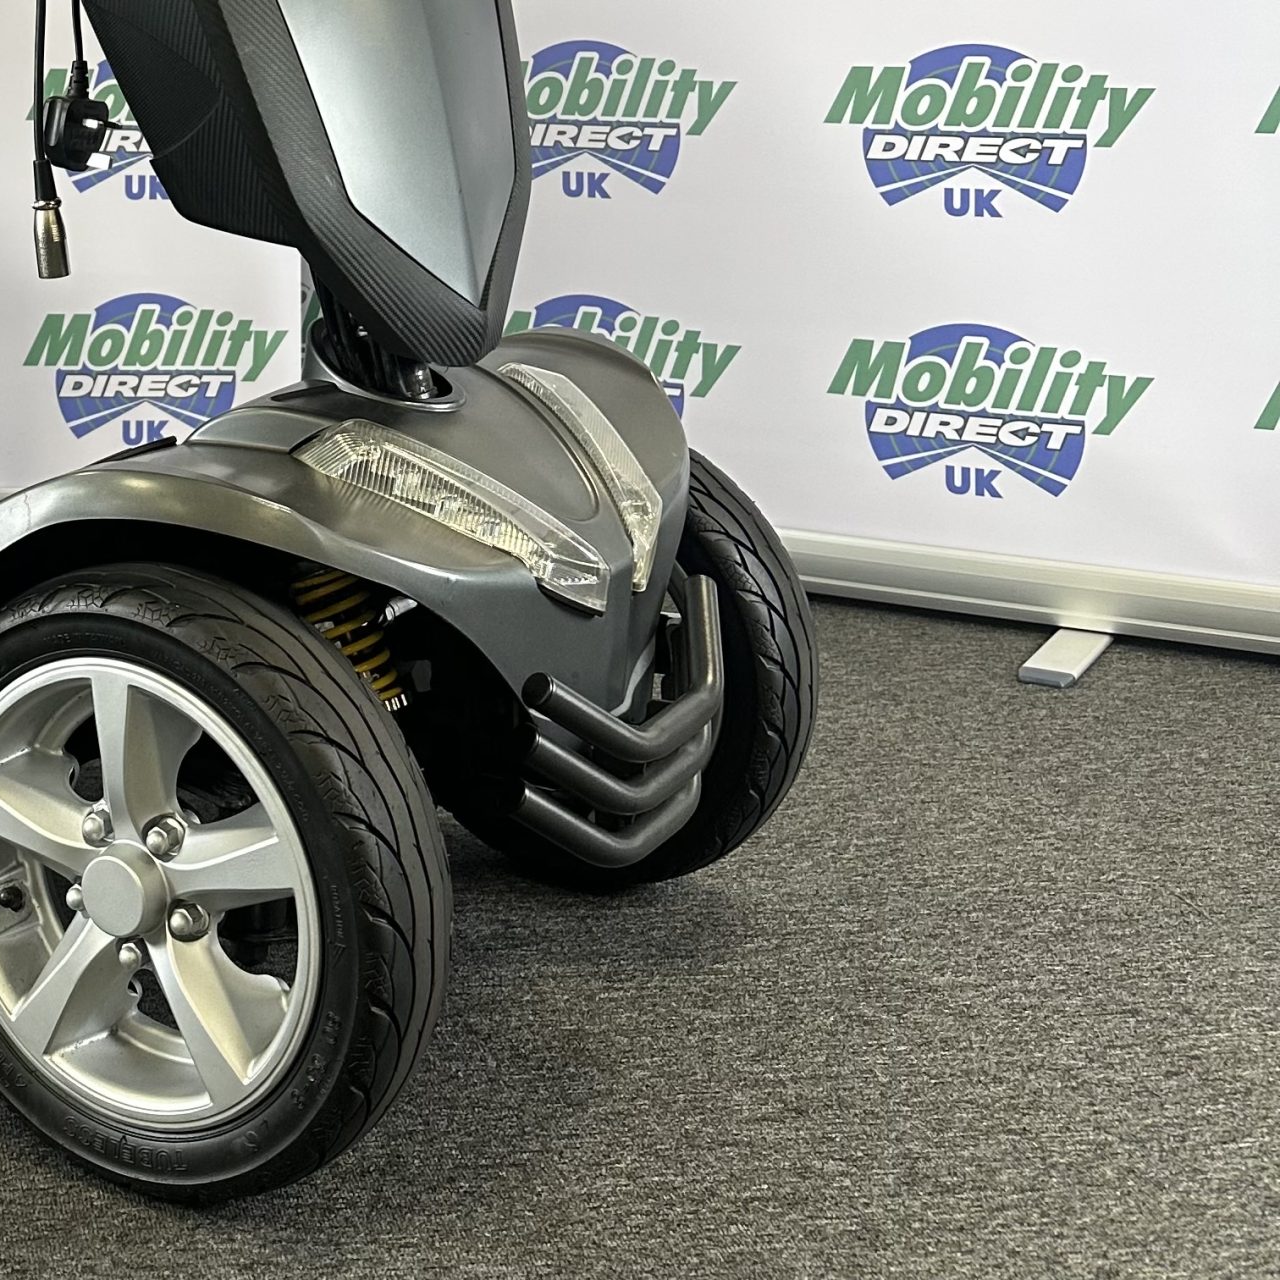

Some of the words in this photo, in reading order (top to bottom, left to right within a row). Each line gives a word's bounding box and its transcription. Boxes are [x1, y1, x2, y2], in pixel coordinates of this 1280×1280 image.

[521, 57, 737, 136] obility
[823, 61, 1156, 148] Mobility
[529, 124, 677, 151] IRECT
[868, 136, 1082, 165] DIRECT
[562, 172, 611, 199] UK
[945, 188, 1002, 218] UK
[23, 309, 288, 382] Mobility
[60, 374, 232, 398] DIRECT
[825, 338, 1152, 436] Mobility
[122, 420, 169, 446] UK
[870, 410, 1080, 450] DIRECT
[946, 466, 1003, 499] UK
[63, 1113, 189, 1171] TUBELESS
